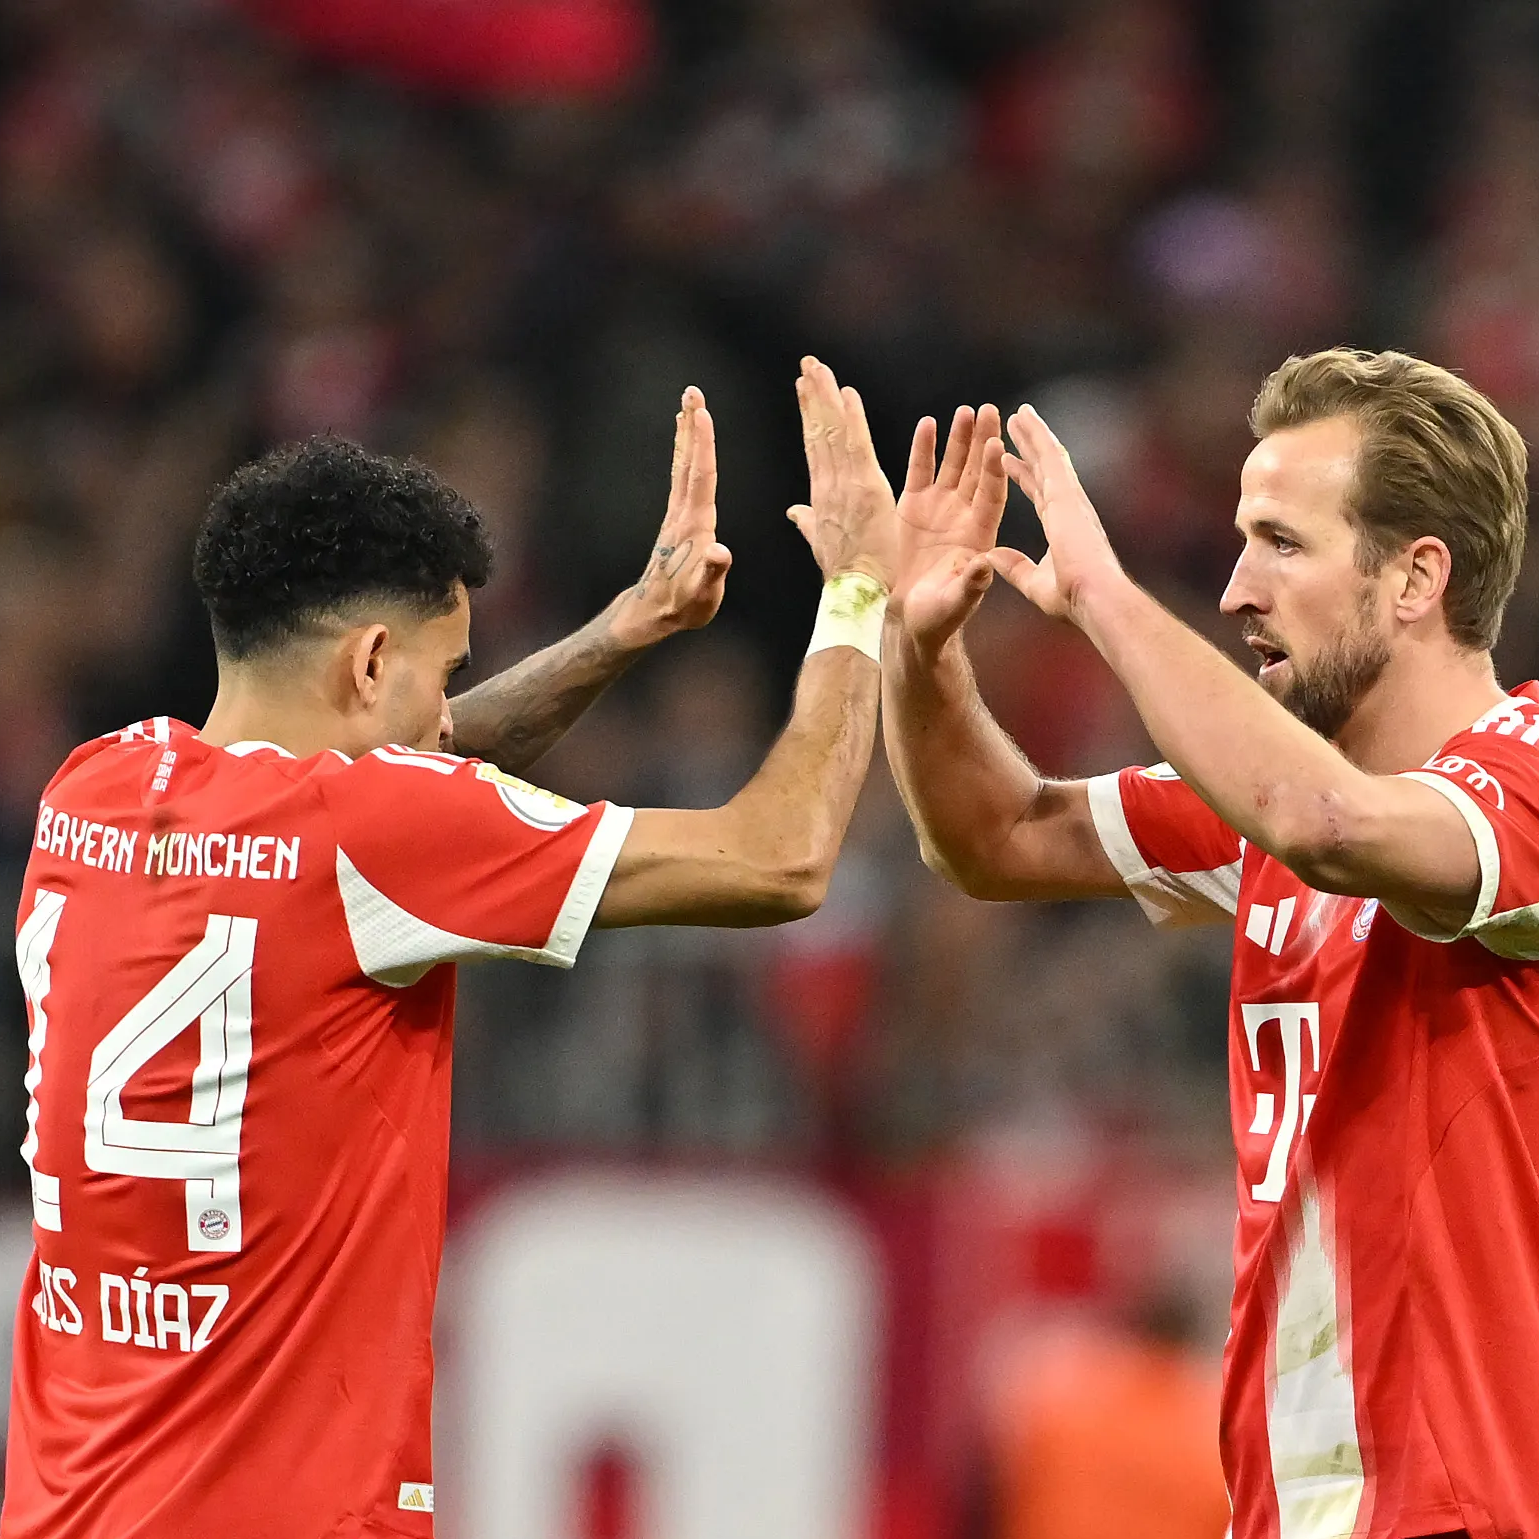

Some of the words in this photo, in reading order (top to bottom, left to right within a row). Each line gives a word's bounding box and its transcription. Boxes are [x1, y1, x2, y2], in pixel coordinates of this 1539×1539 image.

[35, 805, 139, 874] BAYERN
[144, 832, 301, 880] MÜNCHEN
[16, 888, 258, 1252] 14
[99, 1265, 230, 1353] DÍAZ
